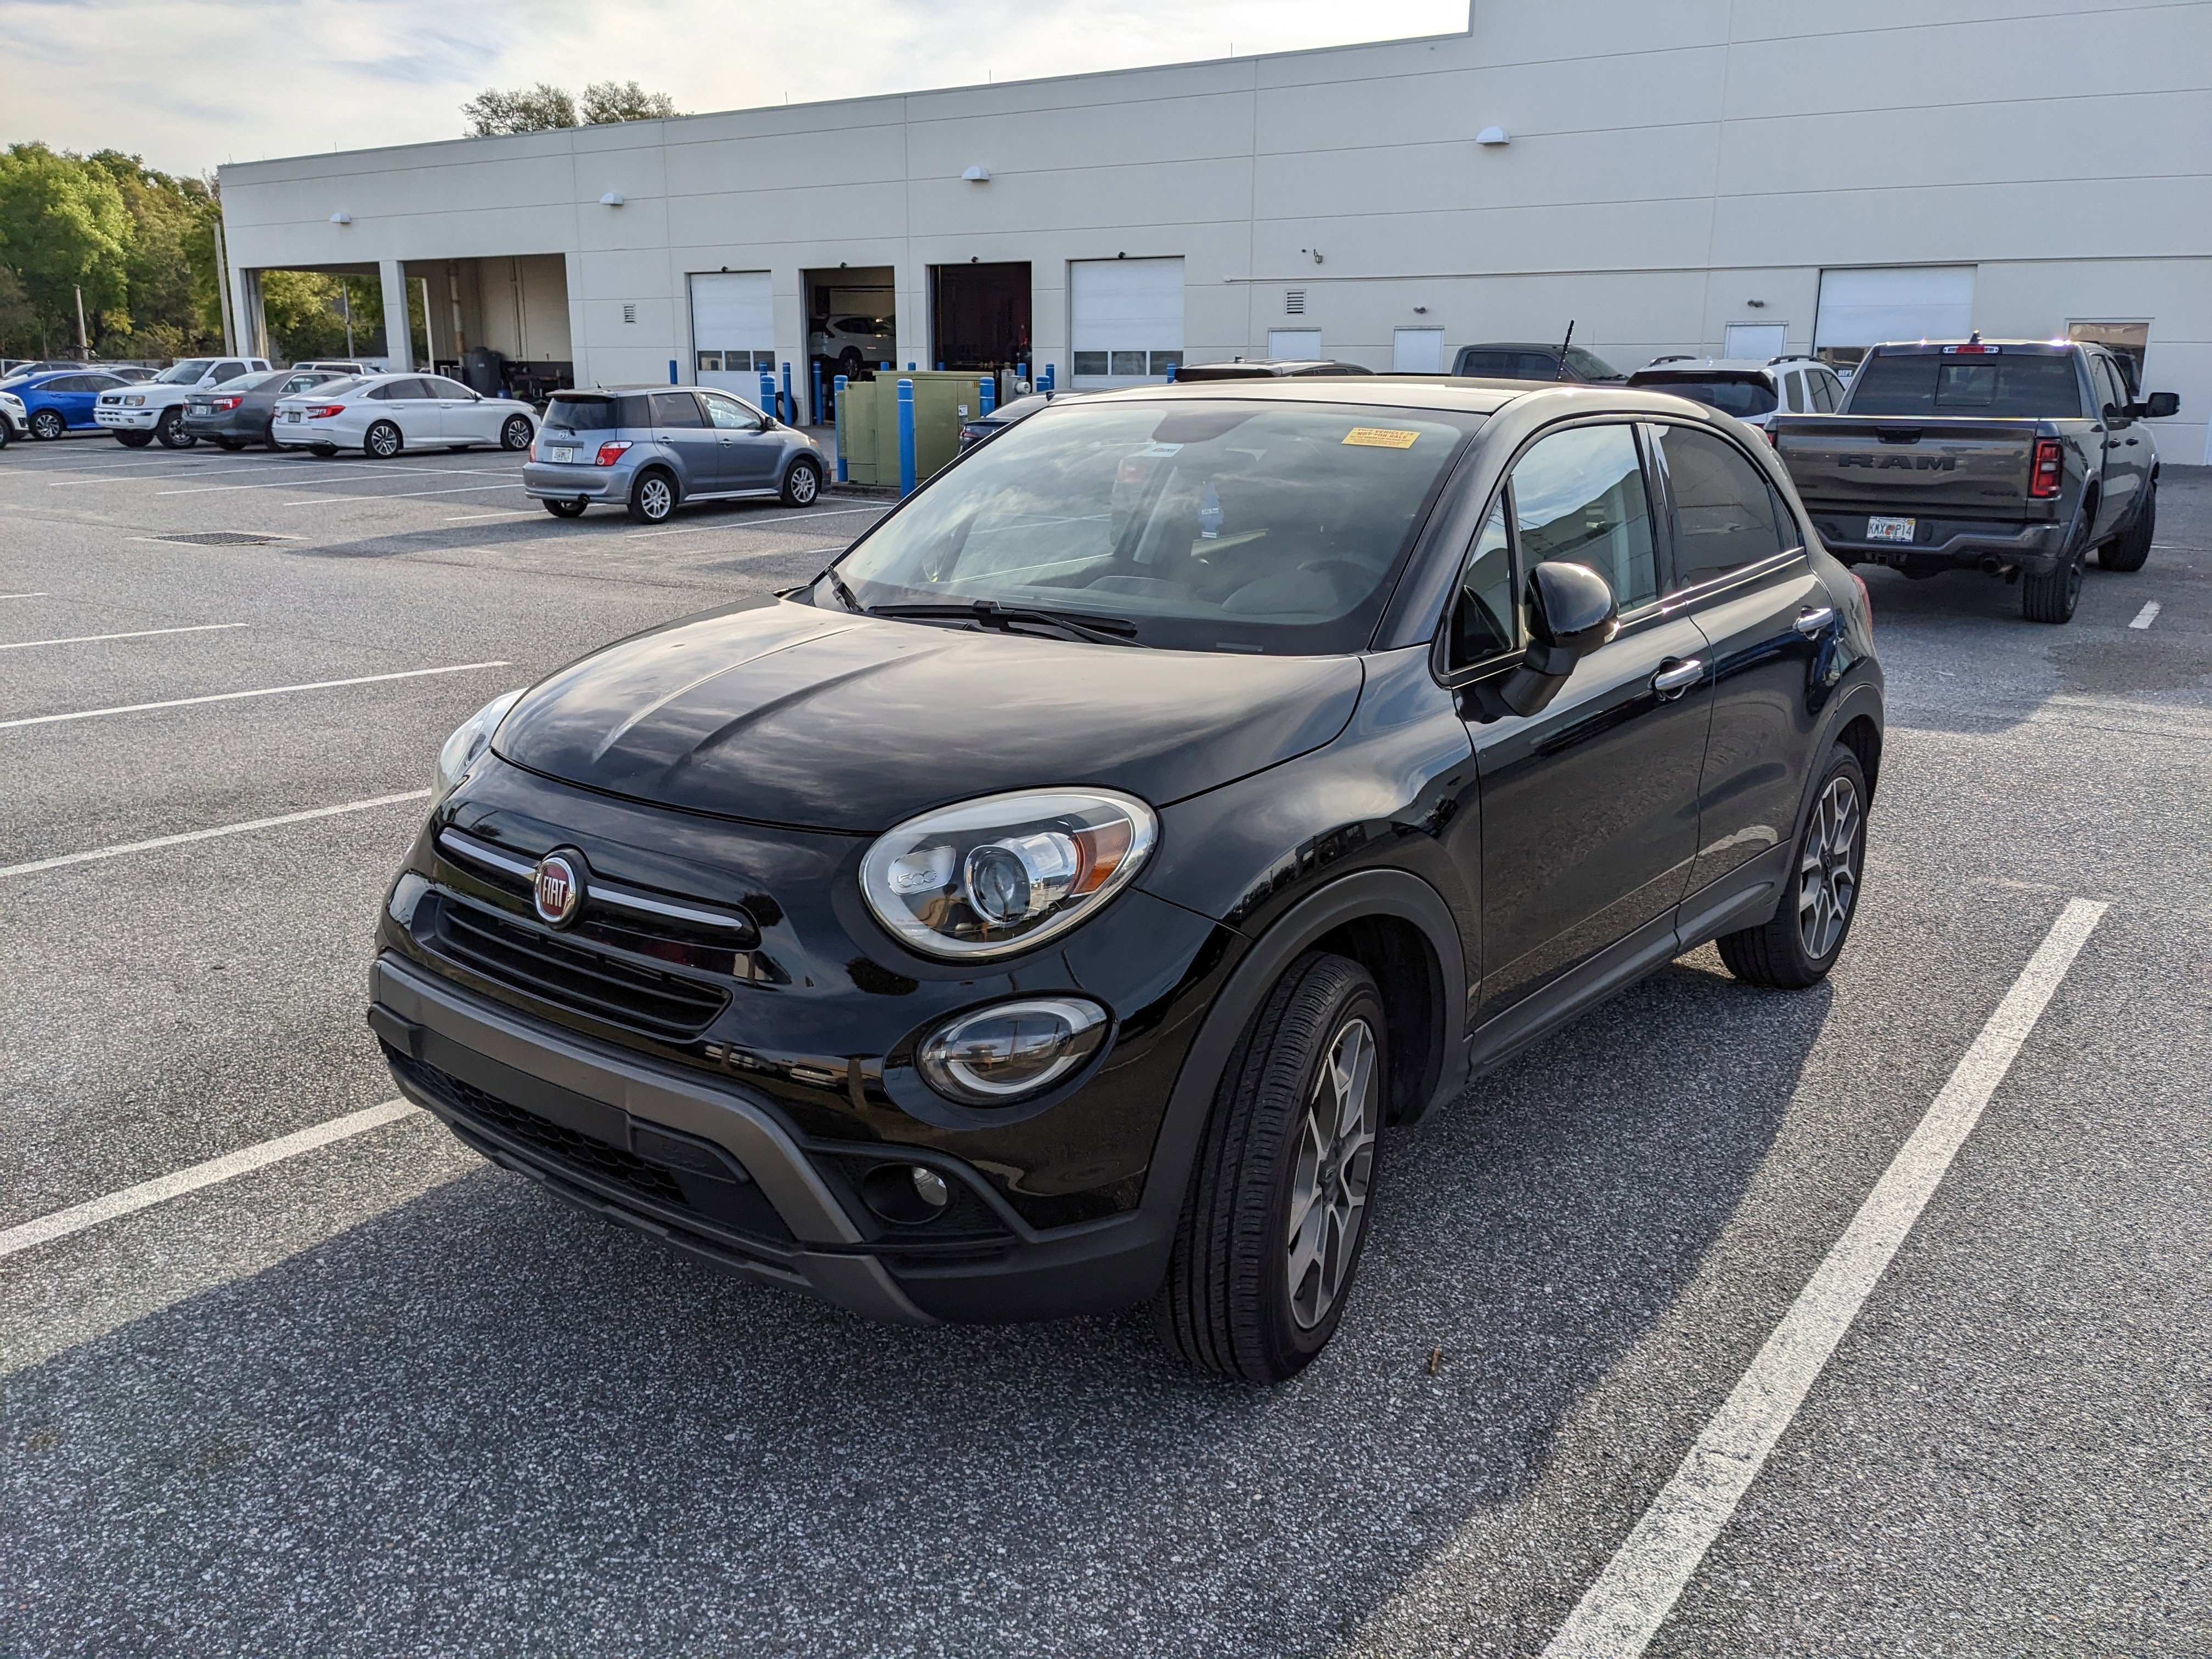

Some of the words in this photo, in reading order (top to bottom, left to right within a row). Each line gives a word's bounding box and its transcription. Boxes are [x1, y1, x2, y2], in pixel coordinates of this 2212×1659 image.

[1838, 453, 1956, 471] RAM
[897, 870, 937, 888] 500
[542, 875, 567, 908] FIAT
